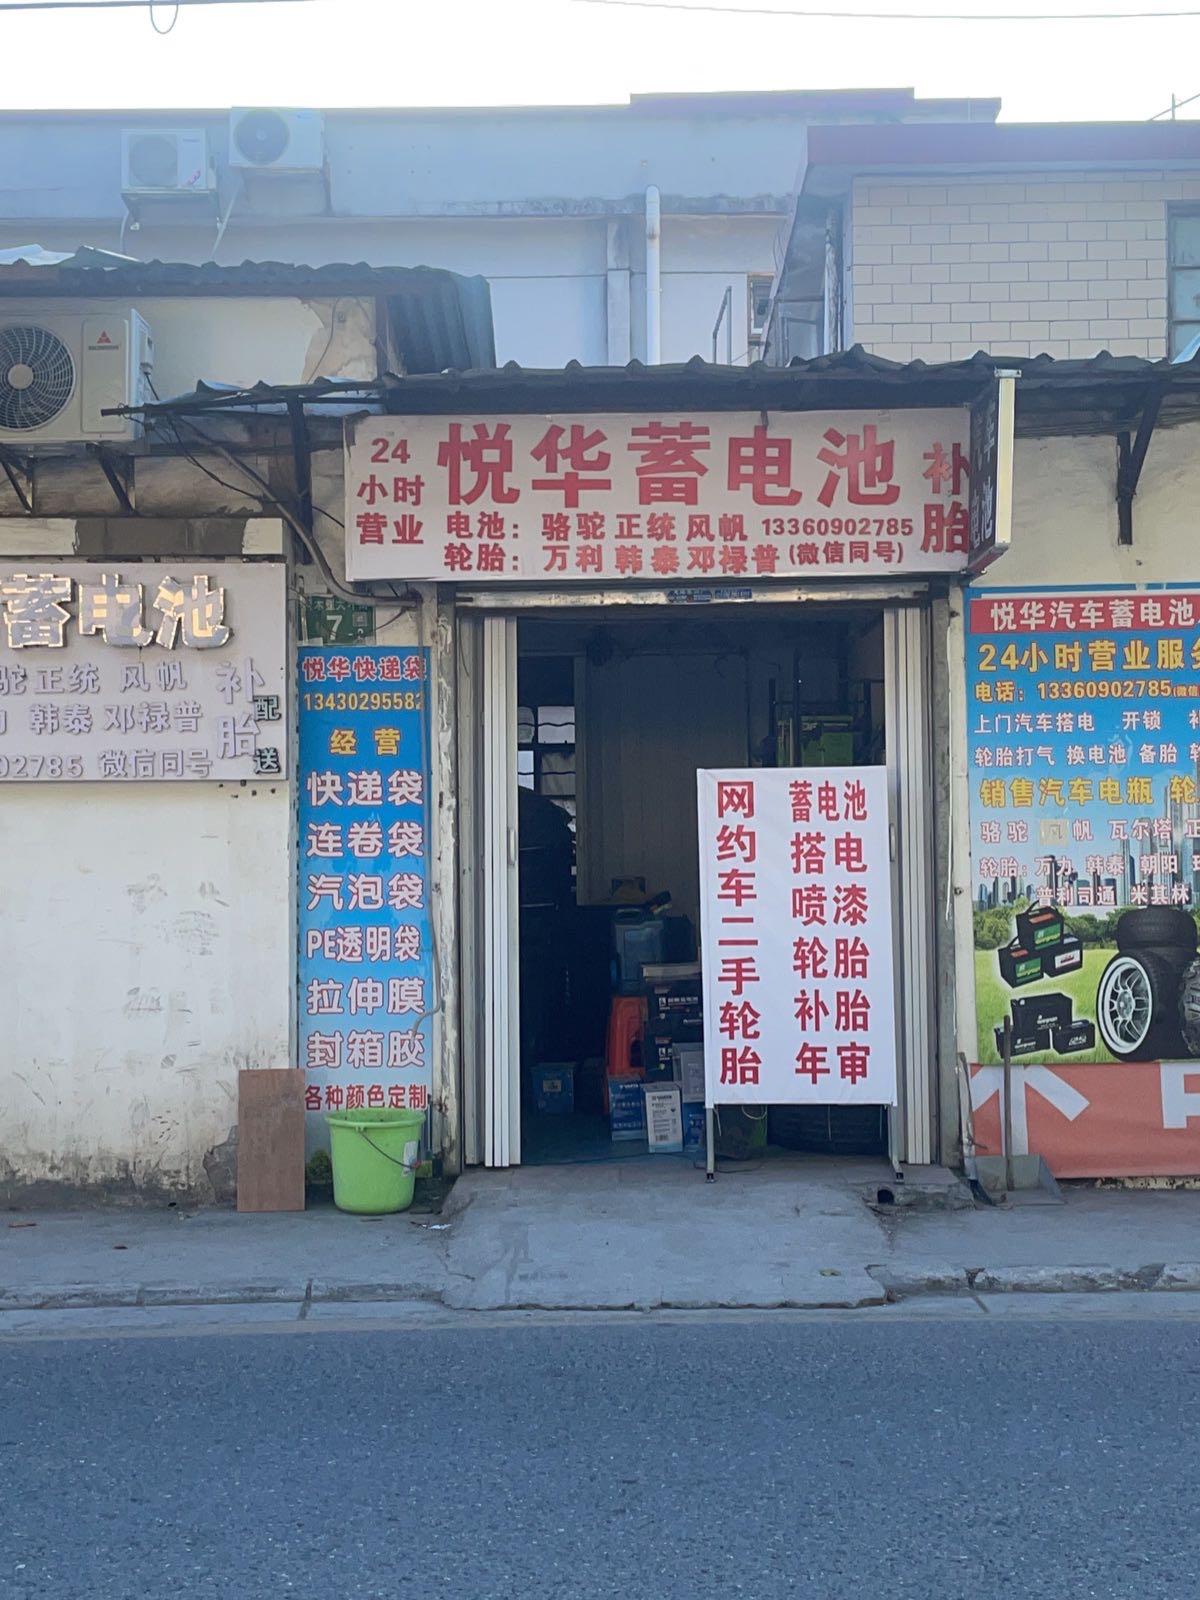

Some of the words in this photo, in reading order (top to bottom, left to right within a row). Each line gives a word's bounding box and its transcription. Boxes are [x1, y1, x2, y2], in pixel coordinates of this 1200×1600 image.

[370, 438, 411, 464] 24
[437, 421, 901, 508] 悦华蓄电池
[357, 474, 425, 506] 小时
[356, 512, 424, 546] 营业
[762, 518, 913, 537] 13360902785
[789, 541, 904, 565] (微信同号)
[1, 574, 230, 649] 蓄电池
[303, 655, 427, 682] 悦华快递袋
[1037, 680, 1171, 699] 13360902785
[216, 657, 265, 760] 补胎
[974, 712, 1095, 734] 上门汽车搭电
[1122, 710, 1162, 731] 开锁
[100, 749, 214, 778] 微信同号
[974, 746, 1055, 767] 轮胎打气
[1067, 745, 1127, 765] 换电池
[1139, 743, 1178, 764] 备胎
[306, 771, 424, 807] 快递袋
[789, 779, 868, 822] 蓄电池
[979, 777, 1154, 808] 销售汽车电瓶
[306, 822, 424, 858] 连卷袋
[1110, 818, 1172, 840] 瓦尔塔
[790, 832, 868, 874] 搭电
[1086, 855, 1125, 875] 韩泰
[1140, 853, 1178, 875] 朝阳
[306, 873, 424, 910] 汽泡袋
[791, 884, 869, 926] 喷漆
[1037, 885, 1116, 906] 普利司通
[1130, 883, 1190, 906] 米其林
[306, 926, 421, 962] PE透明袋
[716, 781, 762, 1086] 网约车二手轮胎
[792, 936, 870, 979] 轮胎
[306, 977, 426, 1015] 拉伸膜
[794, 989, 871, 1032] 补胎
[306, 1030, 426, 1069] 封箱胶
[795, 1042, 871, 1085] 年审
[304, 1084, 428, 1112] 各种颜色定制
